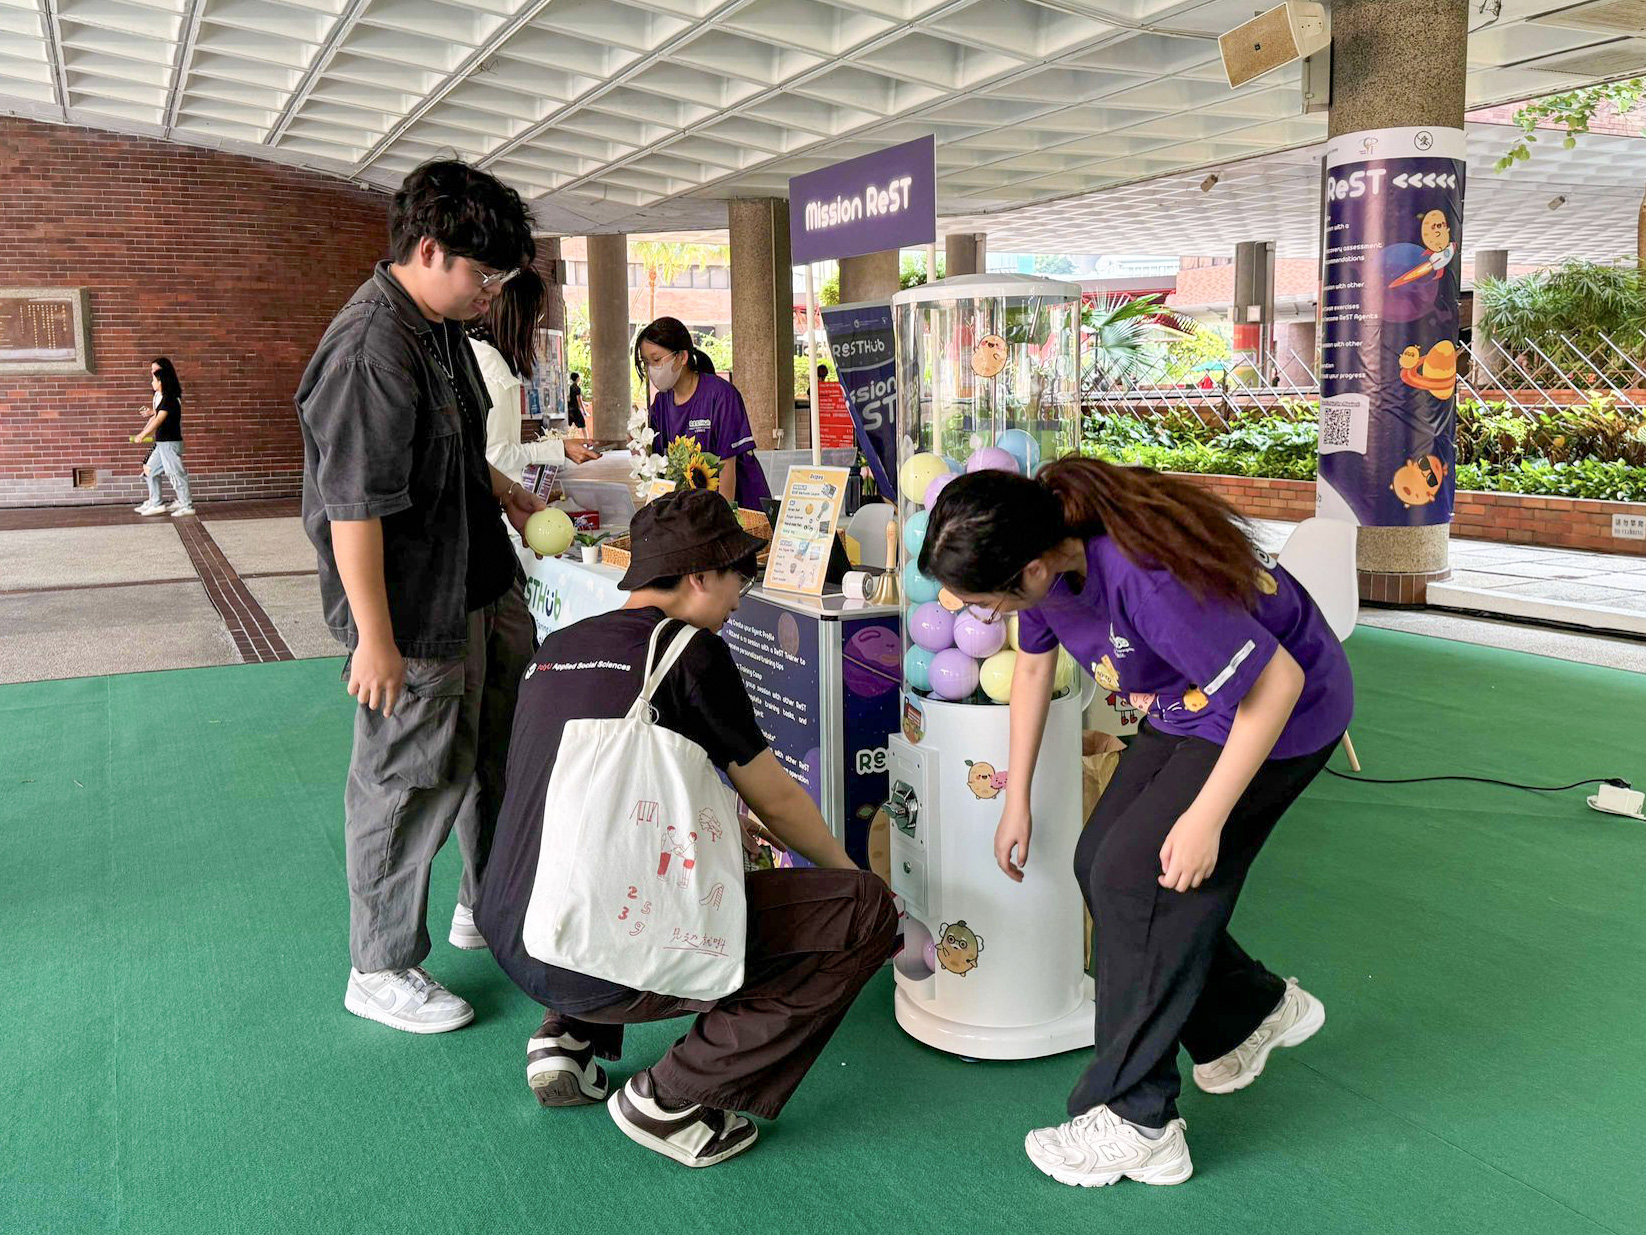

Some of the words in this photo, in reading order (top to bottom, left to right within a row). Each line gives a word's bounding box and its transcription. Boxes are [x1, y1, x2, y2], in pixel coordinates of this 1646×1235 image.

[1327, 168, 1387, 202] ReST
[805, 195, 863, 232] Mission
[865, 176, 913, 218] ReST
[1343, 242, 1383, 252] assessment
[1347, 281, 1365, 289] other
[1334, 303, 1360, 312] exercises
[1353, 312, 1379, 323] Agents
[1345, 340, 1363, 348] other
[1339, 371, 1367, 381] progress
[849, 376, 896, 404] ssion
[862, 393, 897, 431] ST
[762, 630, 775, 641] Profile
[784, 651, 799, 663] Trainer
[552, 662, 577, 672] Applied
[577, 660, 597, 670] Social
[597, 660, 631, 672] Sciences
[757, 685, 772, 696] session
[772, 692, 782, 701] with
[782, 696, 795, 706] other
[795, 700, 807, 712] ReST
[764, 700, 780, 714] training
[798, 716, 808, 725] and
[785, 754, 798, 766] other
[798, 760, 810, 772] ReST
[627, 886, 638, 900] 2
[618, 906, 630, 920] 3
[1099, 1142, 1127, 1162] N
